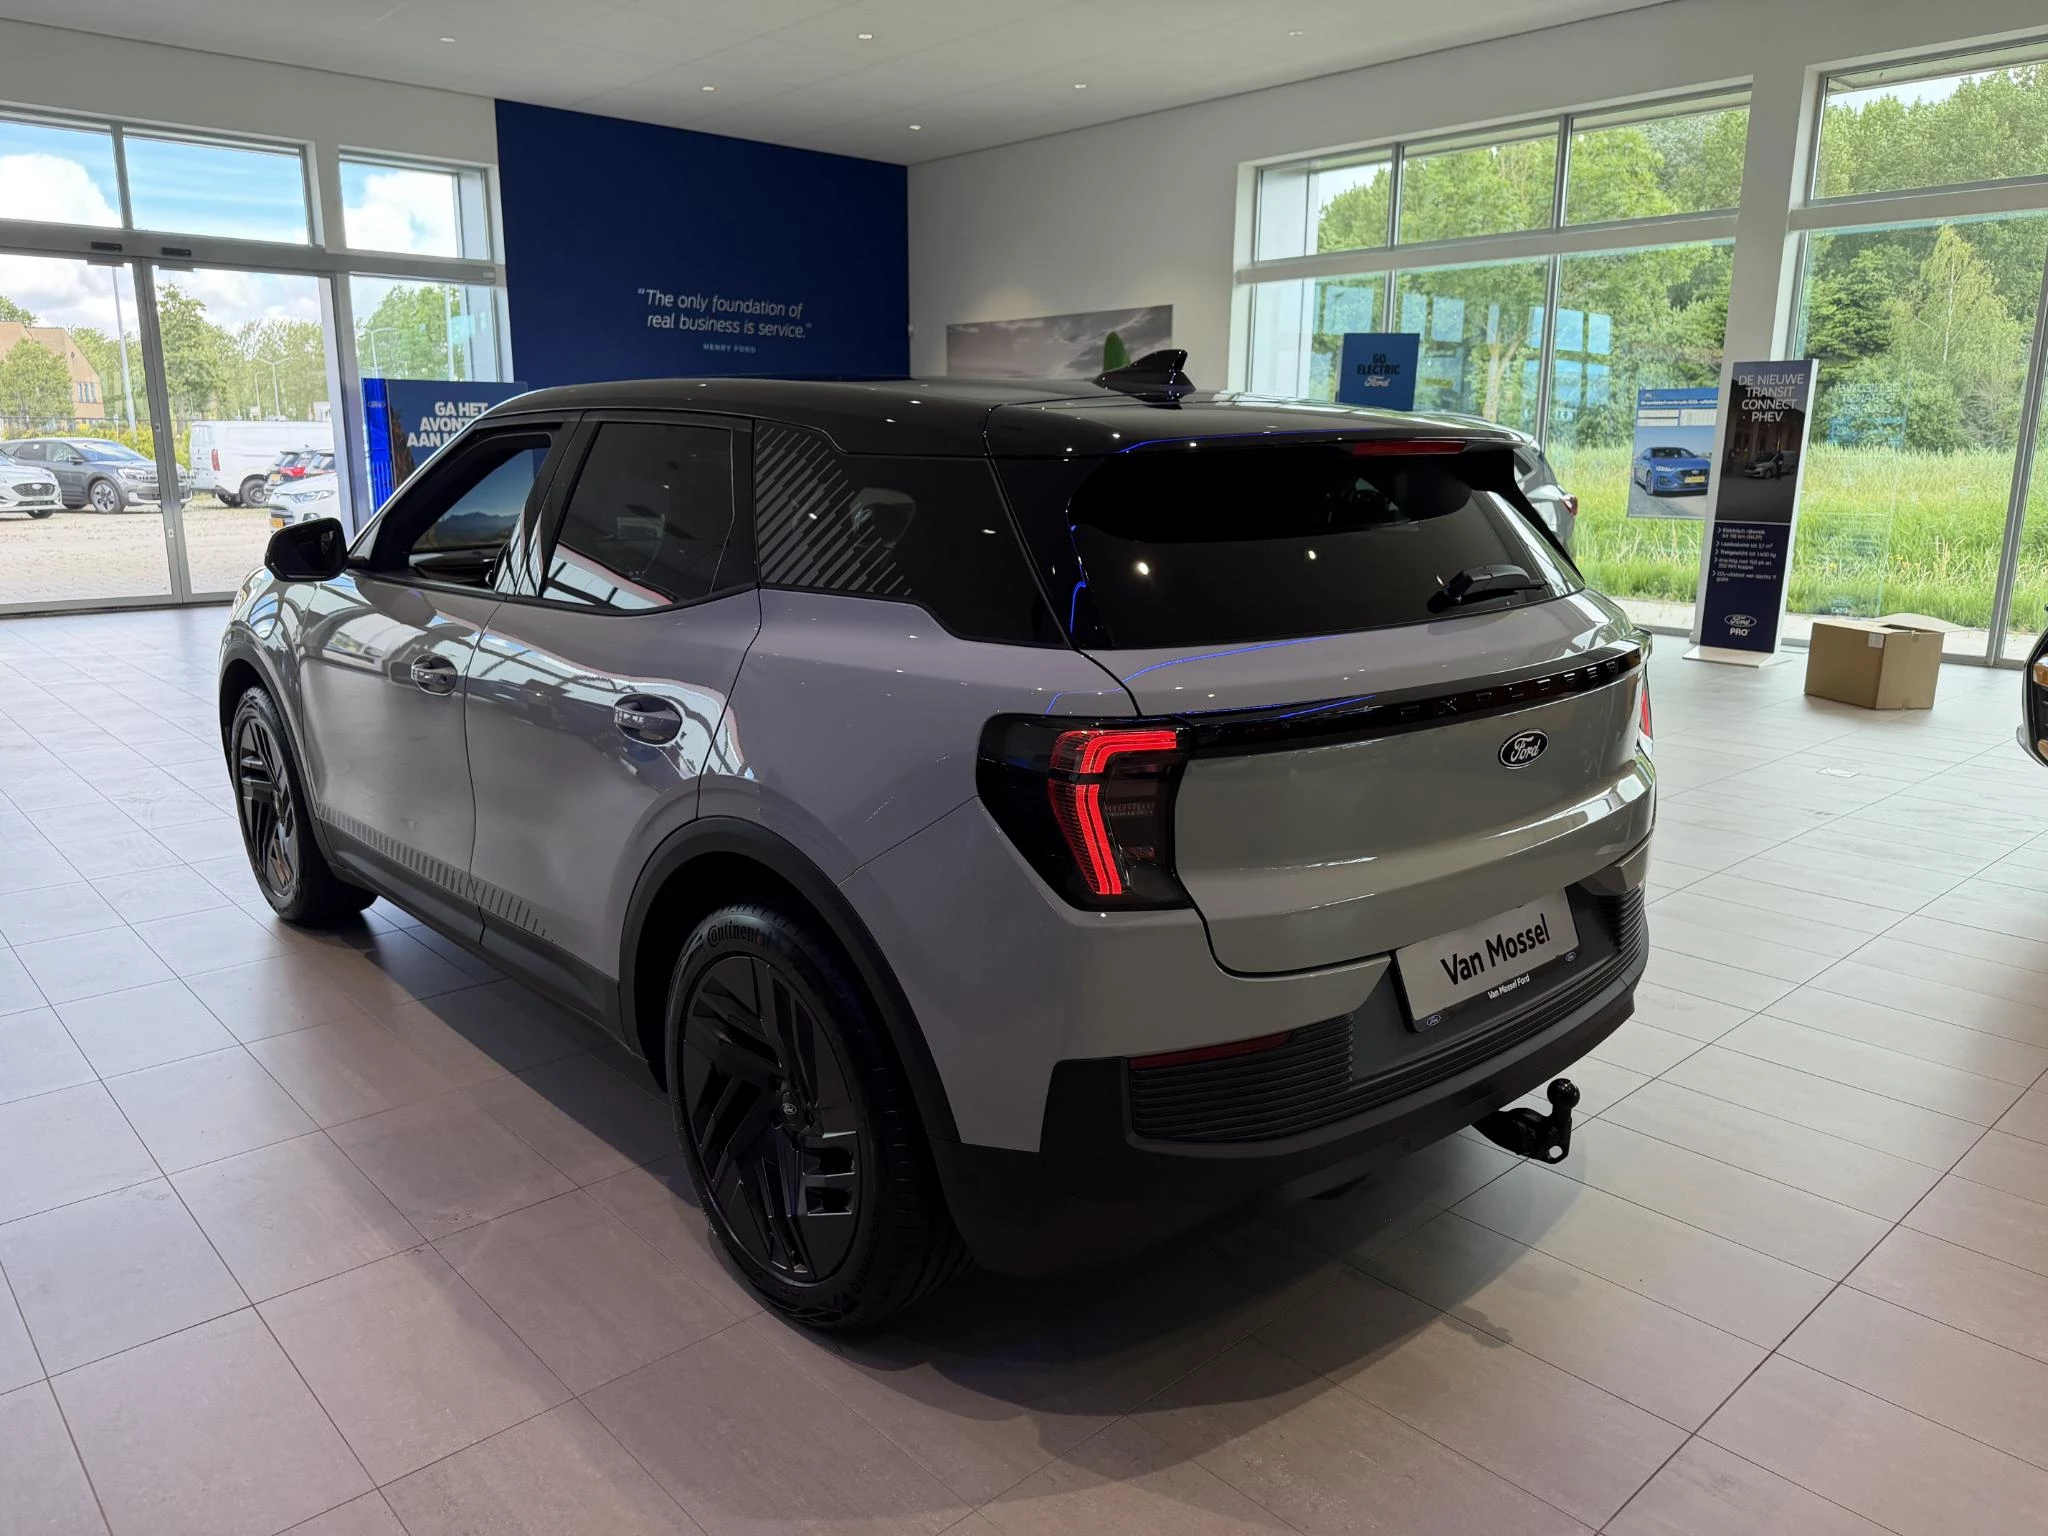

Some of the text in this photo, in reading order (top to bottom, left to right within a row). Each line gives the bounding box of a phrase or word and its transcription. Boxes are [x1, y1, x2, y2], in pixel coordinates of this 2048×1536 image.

[678, 294, 708, 312] only
[712, 295, 786, 317] foundation
[788, 302, 804, 320] of
[647, 313, 675, 329] real
[679, 314, 741, 334] business
[743, 319, 755, 335] is
[702, 343, 757, 354] HENRY FORD
[1372, 353, 1386, 364] GO
[1357, 364, 1401, 376] ELECTRIC
[1738, 373, 1805, 386] DE NIEUWE
[1745, 386, 1795, 398] TRANSIT
[434, 401, 489, 417] GA HET
[1741, 399, 1798, 410] CONNECT
[419, 416, 473, 432] AVONT
[1751, 411, 1784, 422] PHEV
[406, 433, 441, 448] AAN
[1729, 627, 1749, 637] PRO
[1508, 732, 1543, 764] Ford
[707, 920, 772, 949] Continental
[1440, 912, 1551, 986] Van Mossel
[1487, 973, 1530, 1000] Van Mossel Ford
